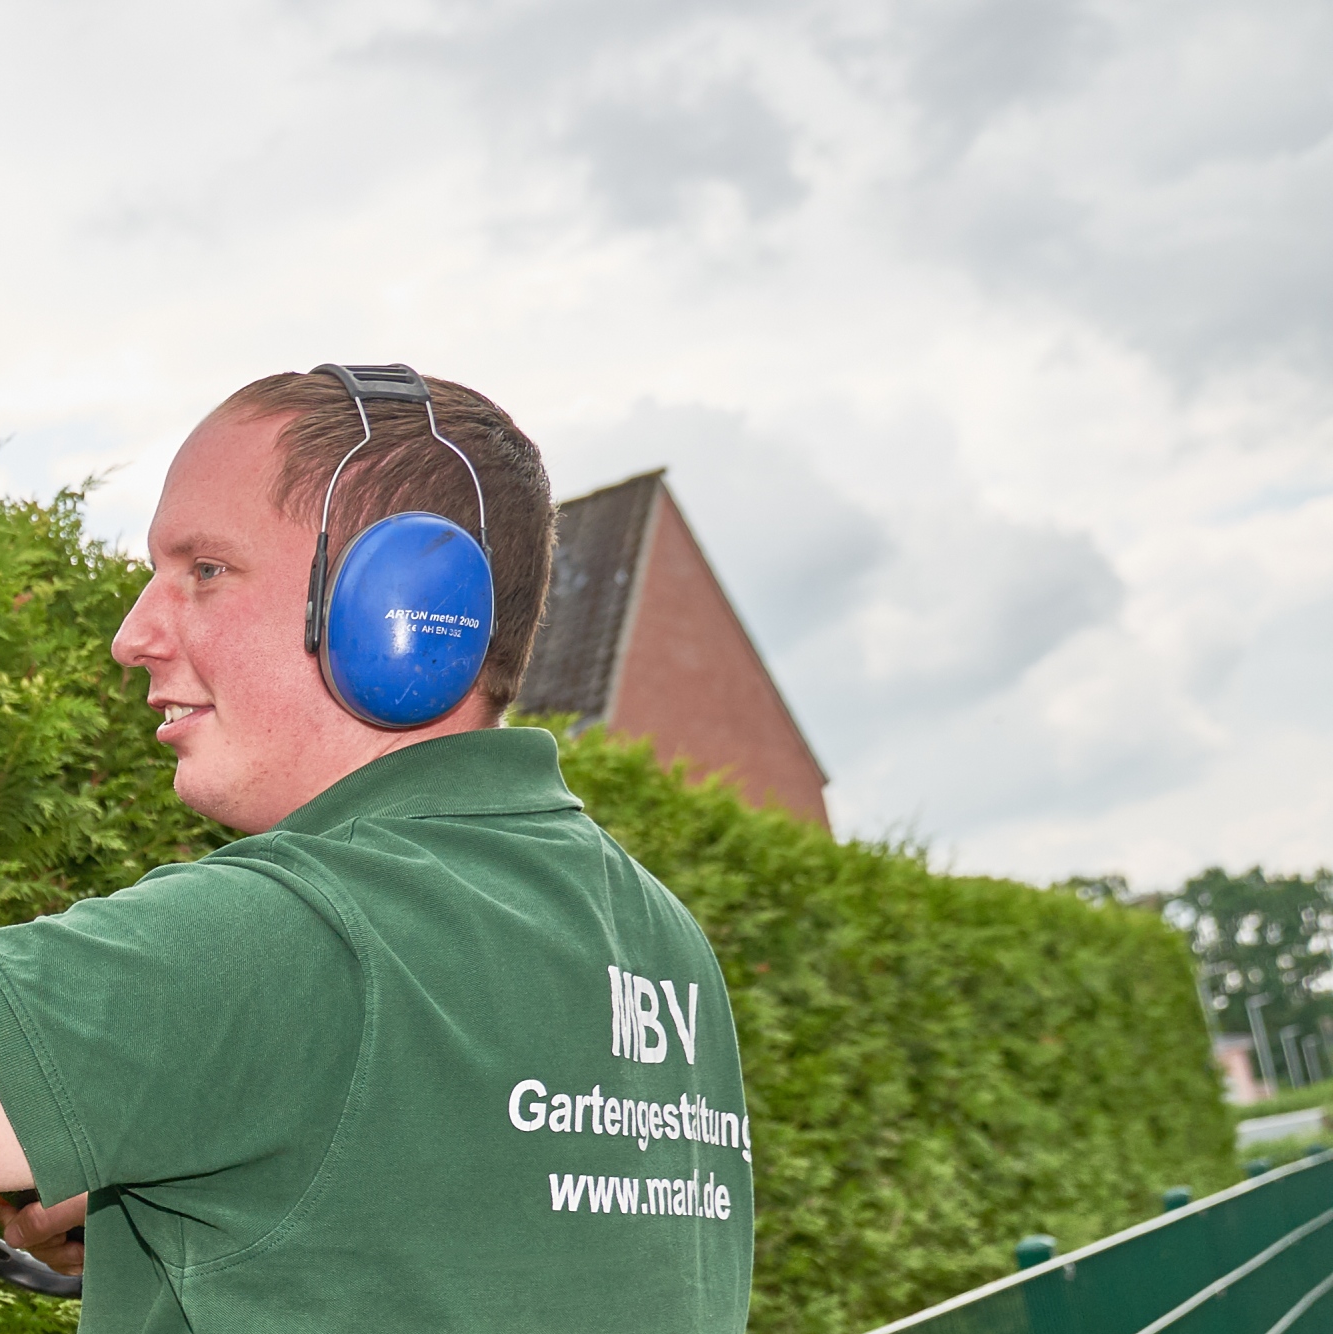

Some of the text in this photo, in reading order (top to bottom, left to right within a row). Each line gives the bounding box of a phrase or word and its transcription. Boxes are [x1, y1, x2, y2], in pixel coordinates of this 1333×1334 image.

[385, 609, 480, 629] ARTON metal 2000
[436, 626, 447, 635] EN
